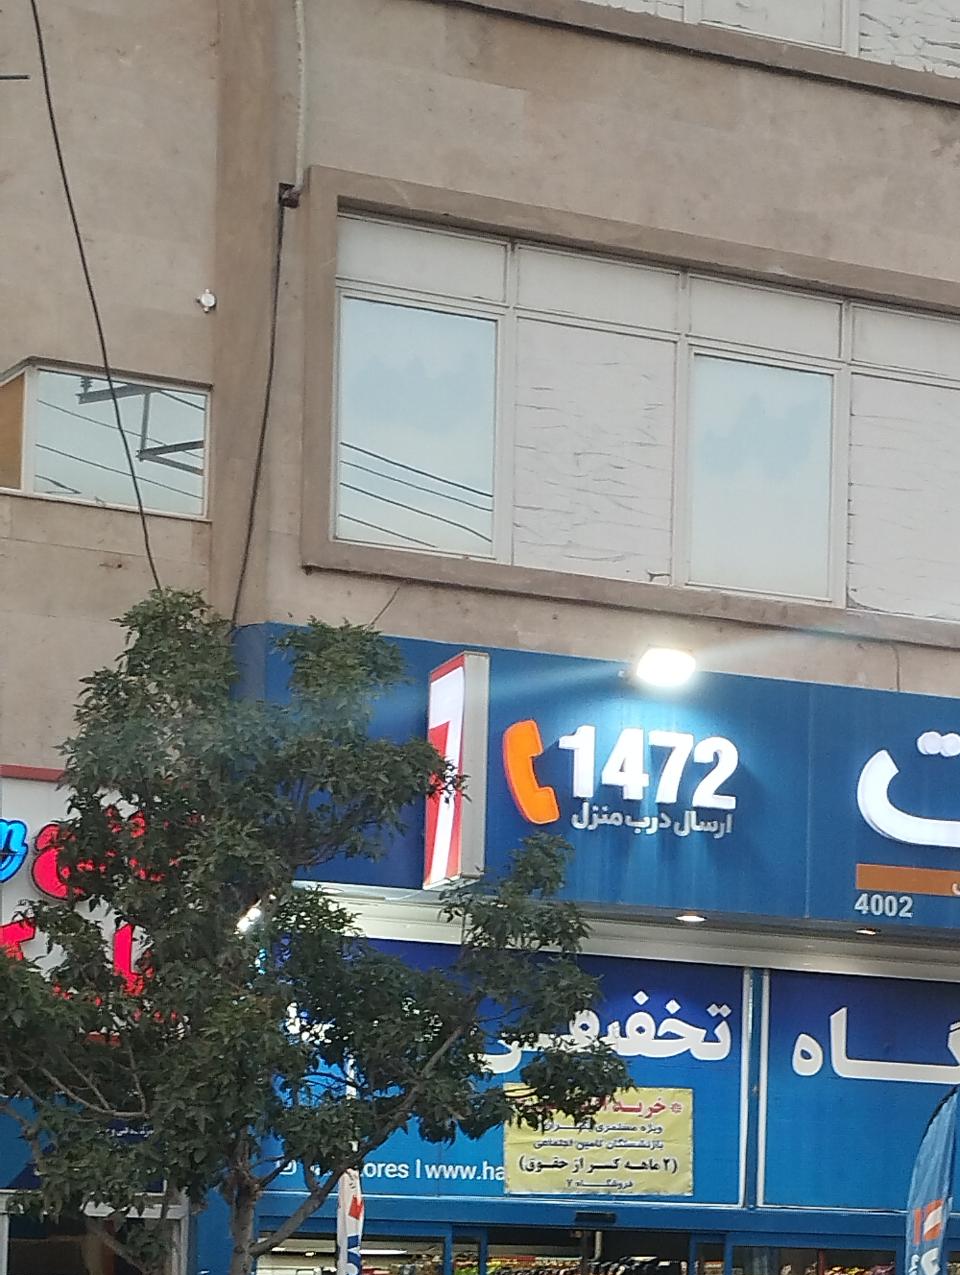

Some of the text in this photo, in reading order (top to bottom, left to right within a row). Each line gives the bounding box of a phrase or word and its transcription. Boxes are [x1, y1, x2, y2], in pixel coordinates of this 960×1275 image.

[558, 724, 739, 810] 1472
[571, 802, 733, 838] ارسال درب منزل
[854, 892, 914, 918] 4002
[613, 1098, 666, 1118] خرید
